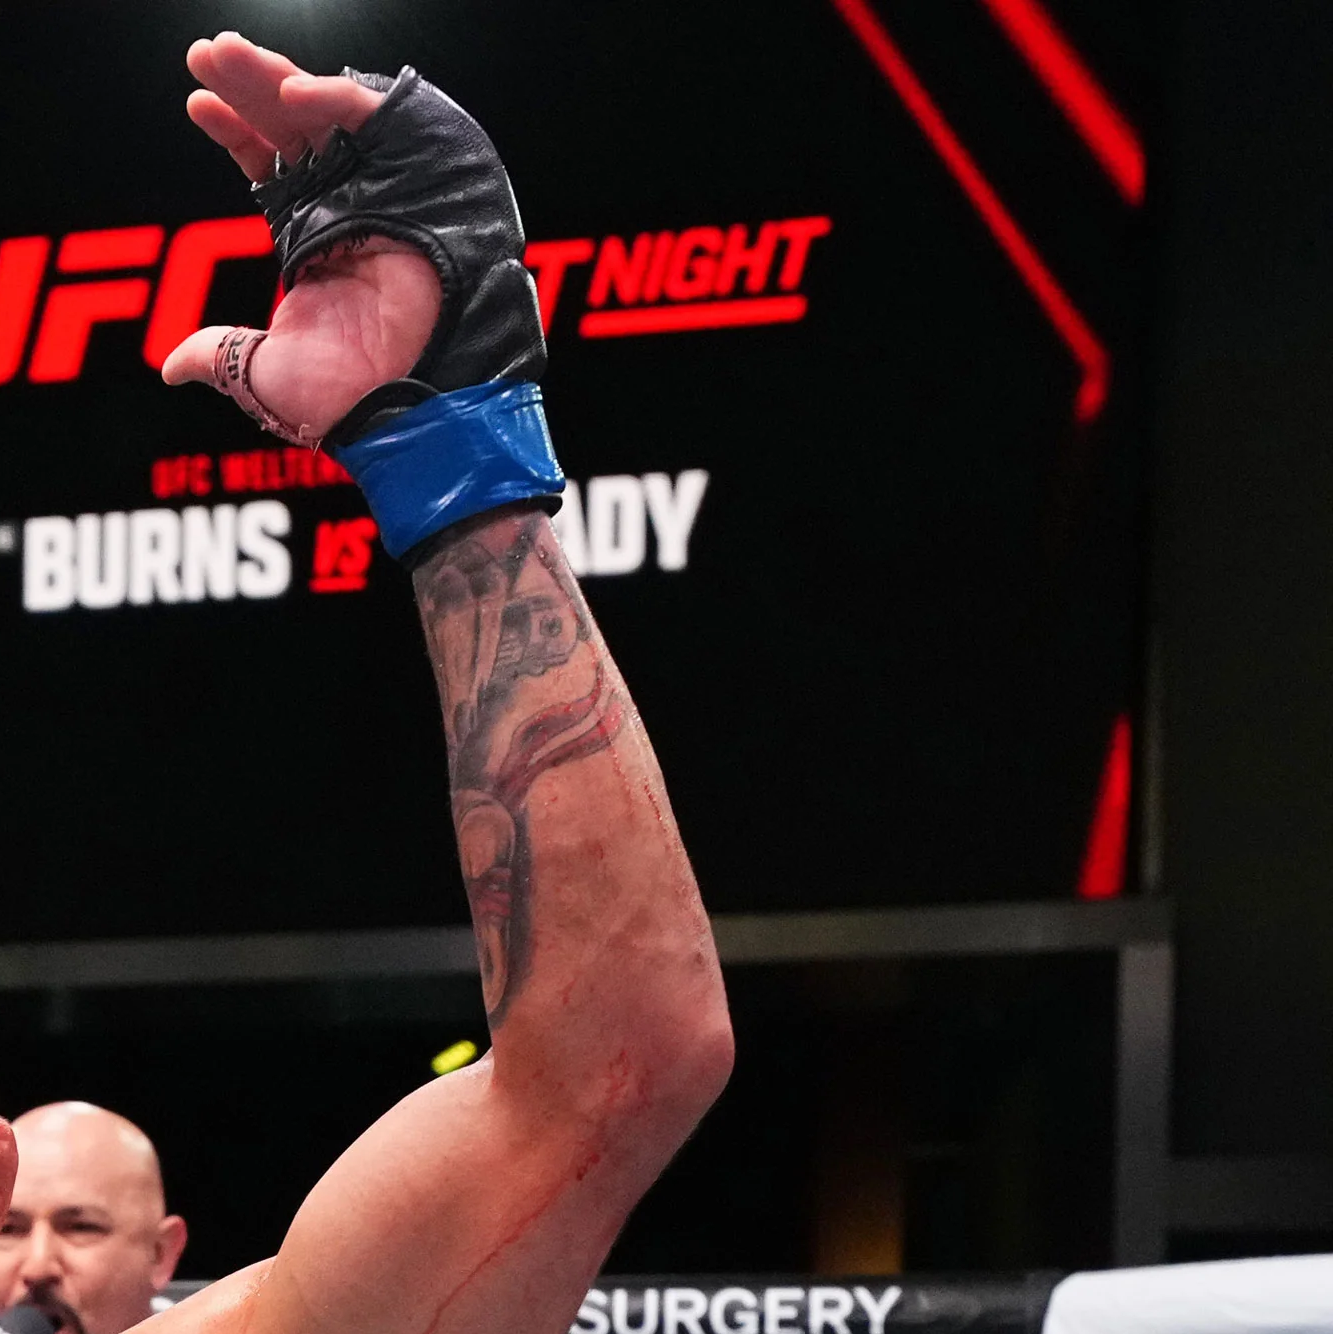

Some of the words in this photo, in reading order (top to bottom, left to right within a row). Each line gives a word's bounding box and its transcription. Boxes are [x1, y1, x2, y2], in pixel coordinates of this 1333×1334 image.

[586, 215, 831, 308] NIGHT
[151, 453, 213, 499] UFC
[22, 499, 293, 613] BURNS
[312, 516, 379, 580] VS
[552, 468, 709, 577] ADY
